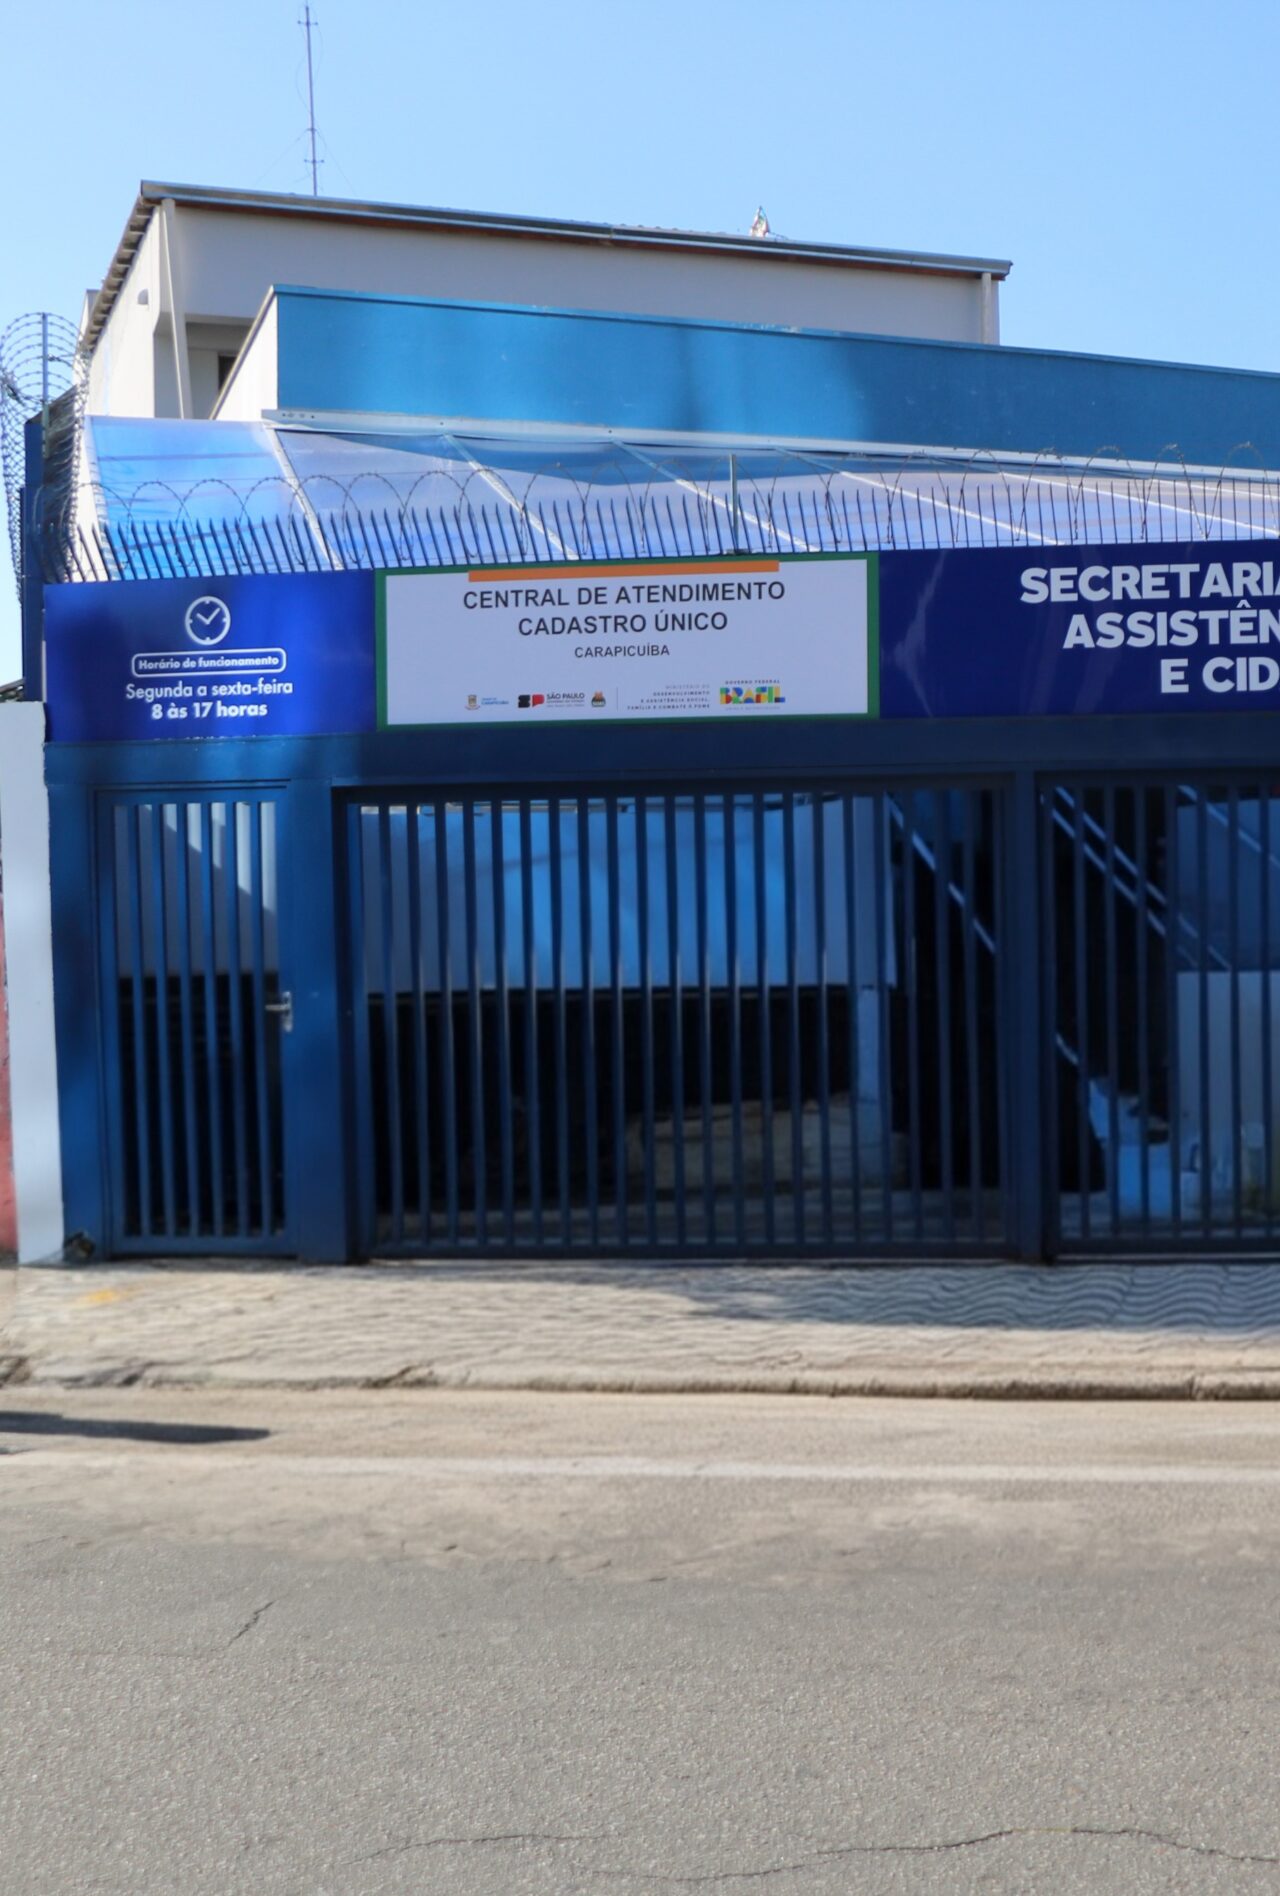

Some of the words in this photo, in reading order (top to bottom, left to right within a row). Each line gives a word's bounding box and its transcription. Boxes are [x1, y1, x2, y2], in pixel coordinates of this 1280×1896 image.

[463, 588, 569, 610] CENTRAL
[578, 587, 608, 606] DE
[616, 581, 785, 605] ATENDIMENTO
[518, 614, 647, 636] CADASTRO
[655, 609, 728, 632] ÚNICO
[574, 643, 670, 659] CARAPICUÍBA
[138, 658, 181, 671] Horário
[182, 657, 196, 669] de
[198, 655, 280, 668] funcionamento
[1160, 658, 1188, 694] E
[125, 681, 193, 702] Segunda
[197, 685, 207, 697] a
[212, 677, 293, 697] sexta-feira
[546, 692, 560, 700] SÃO
[720, 686, 785, 704] BRASIL
[151, 705, 163, 720] 8
[166, 701, 188, 720] às
[193, 703, 212, 719] 17
[216, 699, 268, 718] horas
